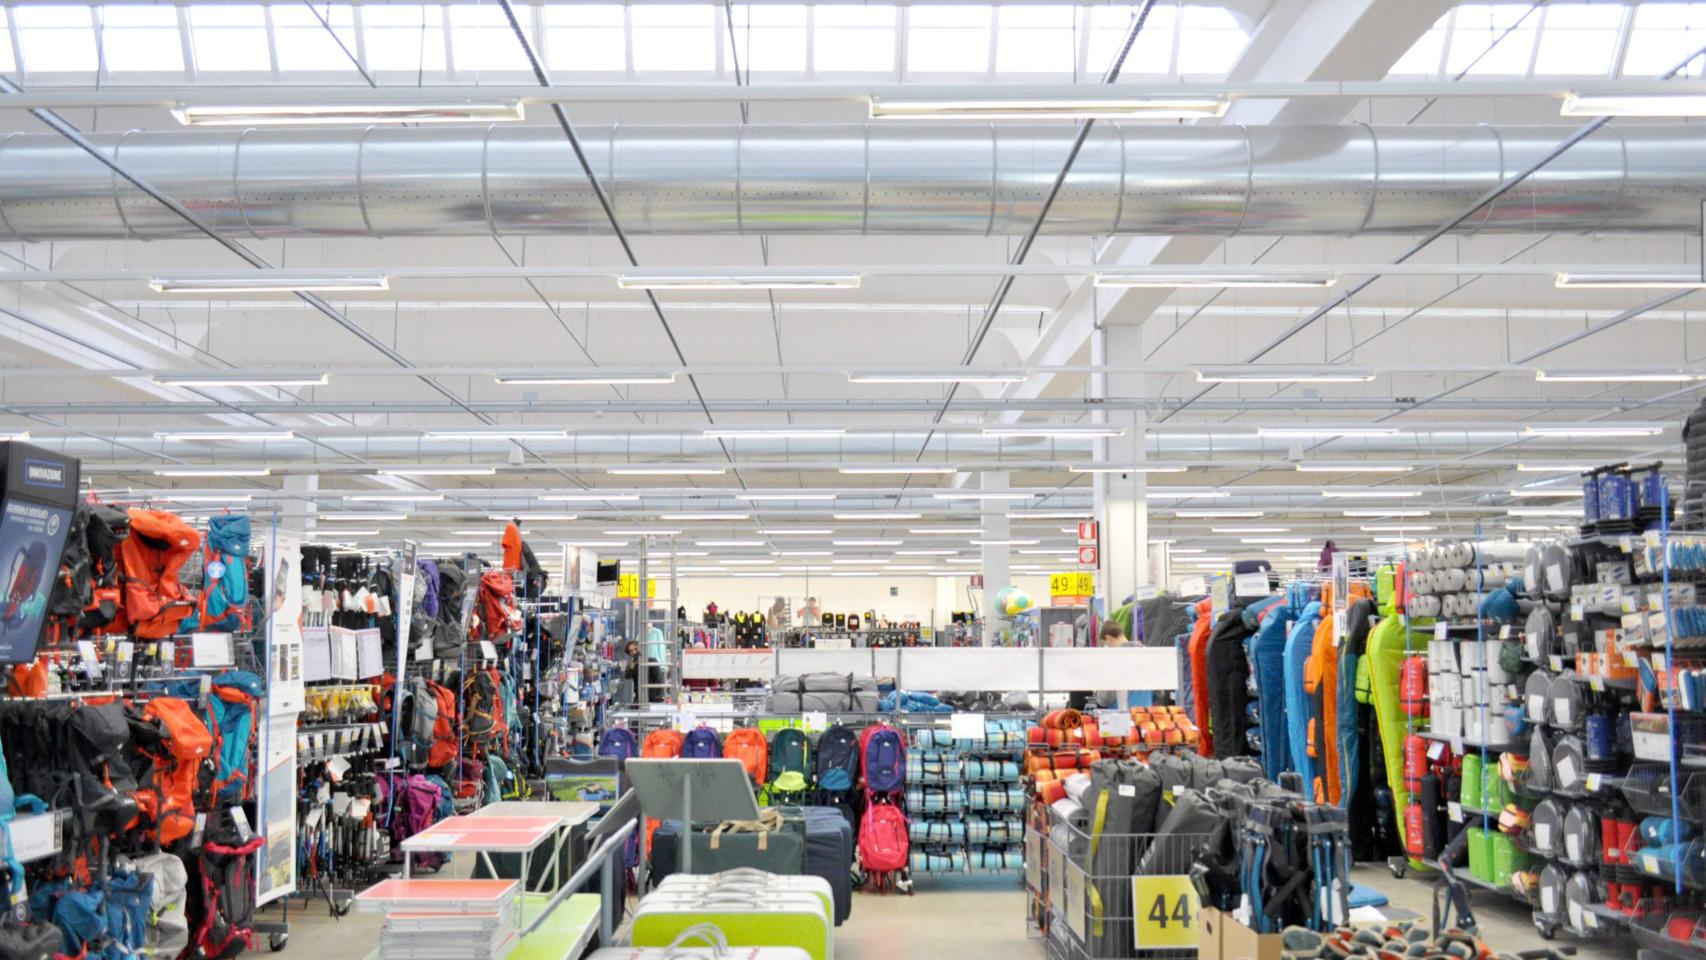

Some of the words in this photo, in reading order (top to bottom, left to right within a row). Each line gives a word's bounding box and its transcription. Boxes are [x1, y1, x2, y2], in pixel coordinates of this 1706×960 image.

[29, 466, 62, 481] INNOVAZIONE
[1051, 576, 1069, 592] 49
[1148, 893, 1192, 928] 44
